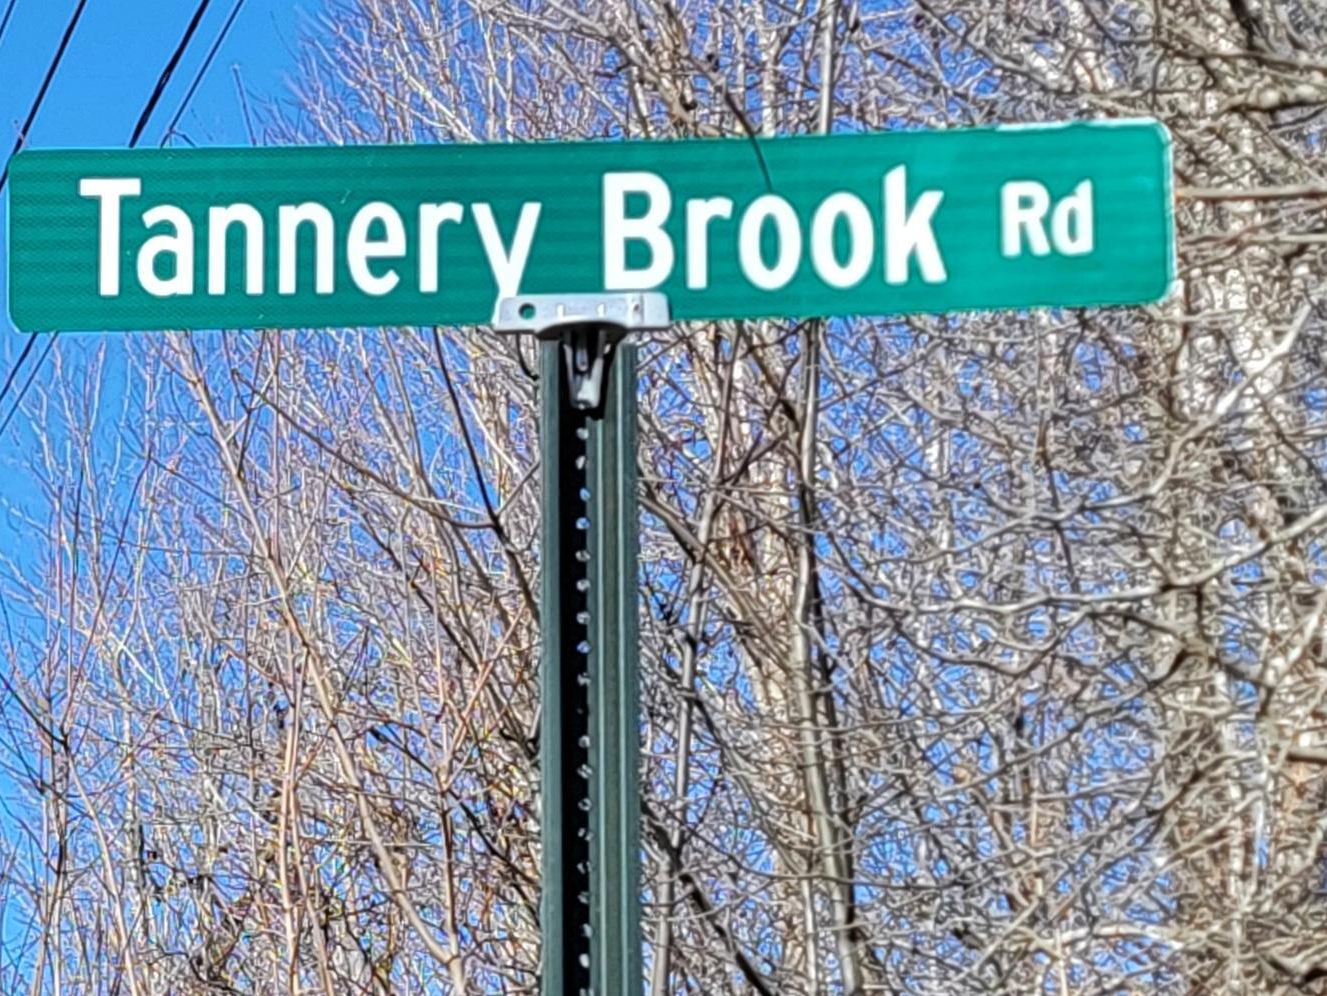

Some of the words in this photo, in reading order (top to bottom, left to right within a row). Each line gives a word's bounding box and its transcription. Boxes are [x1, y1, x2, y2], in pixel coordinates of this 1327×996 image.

[79, 177, 541, 322] Tannery
[603, 166, 947, 291] Brook
[1002, 180, 1094, 257] Rd
